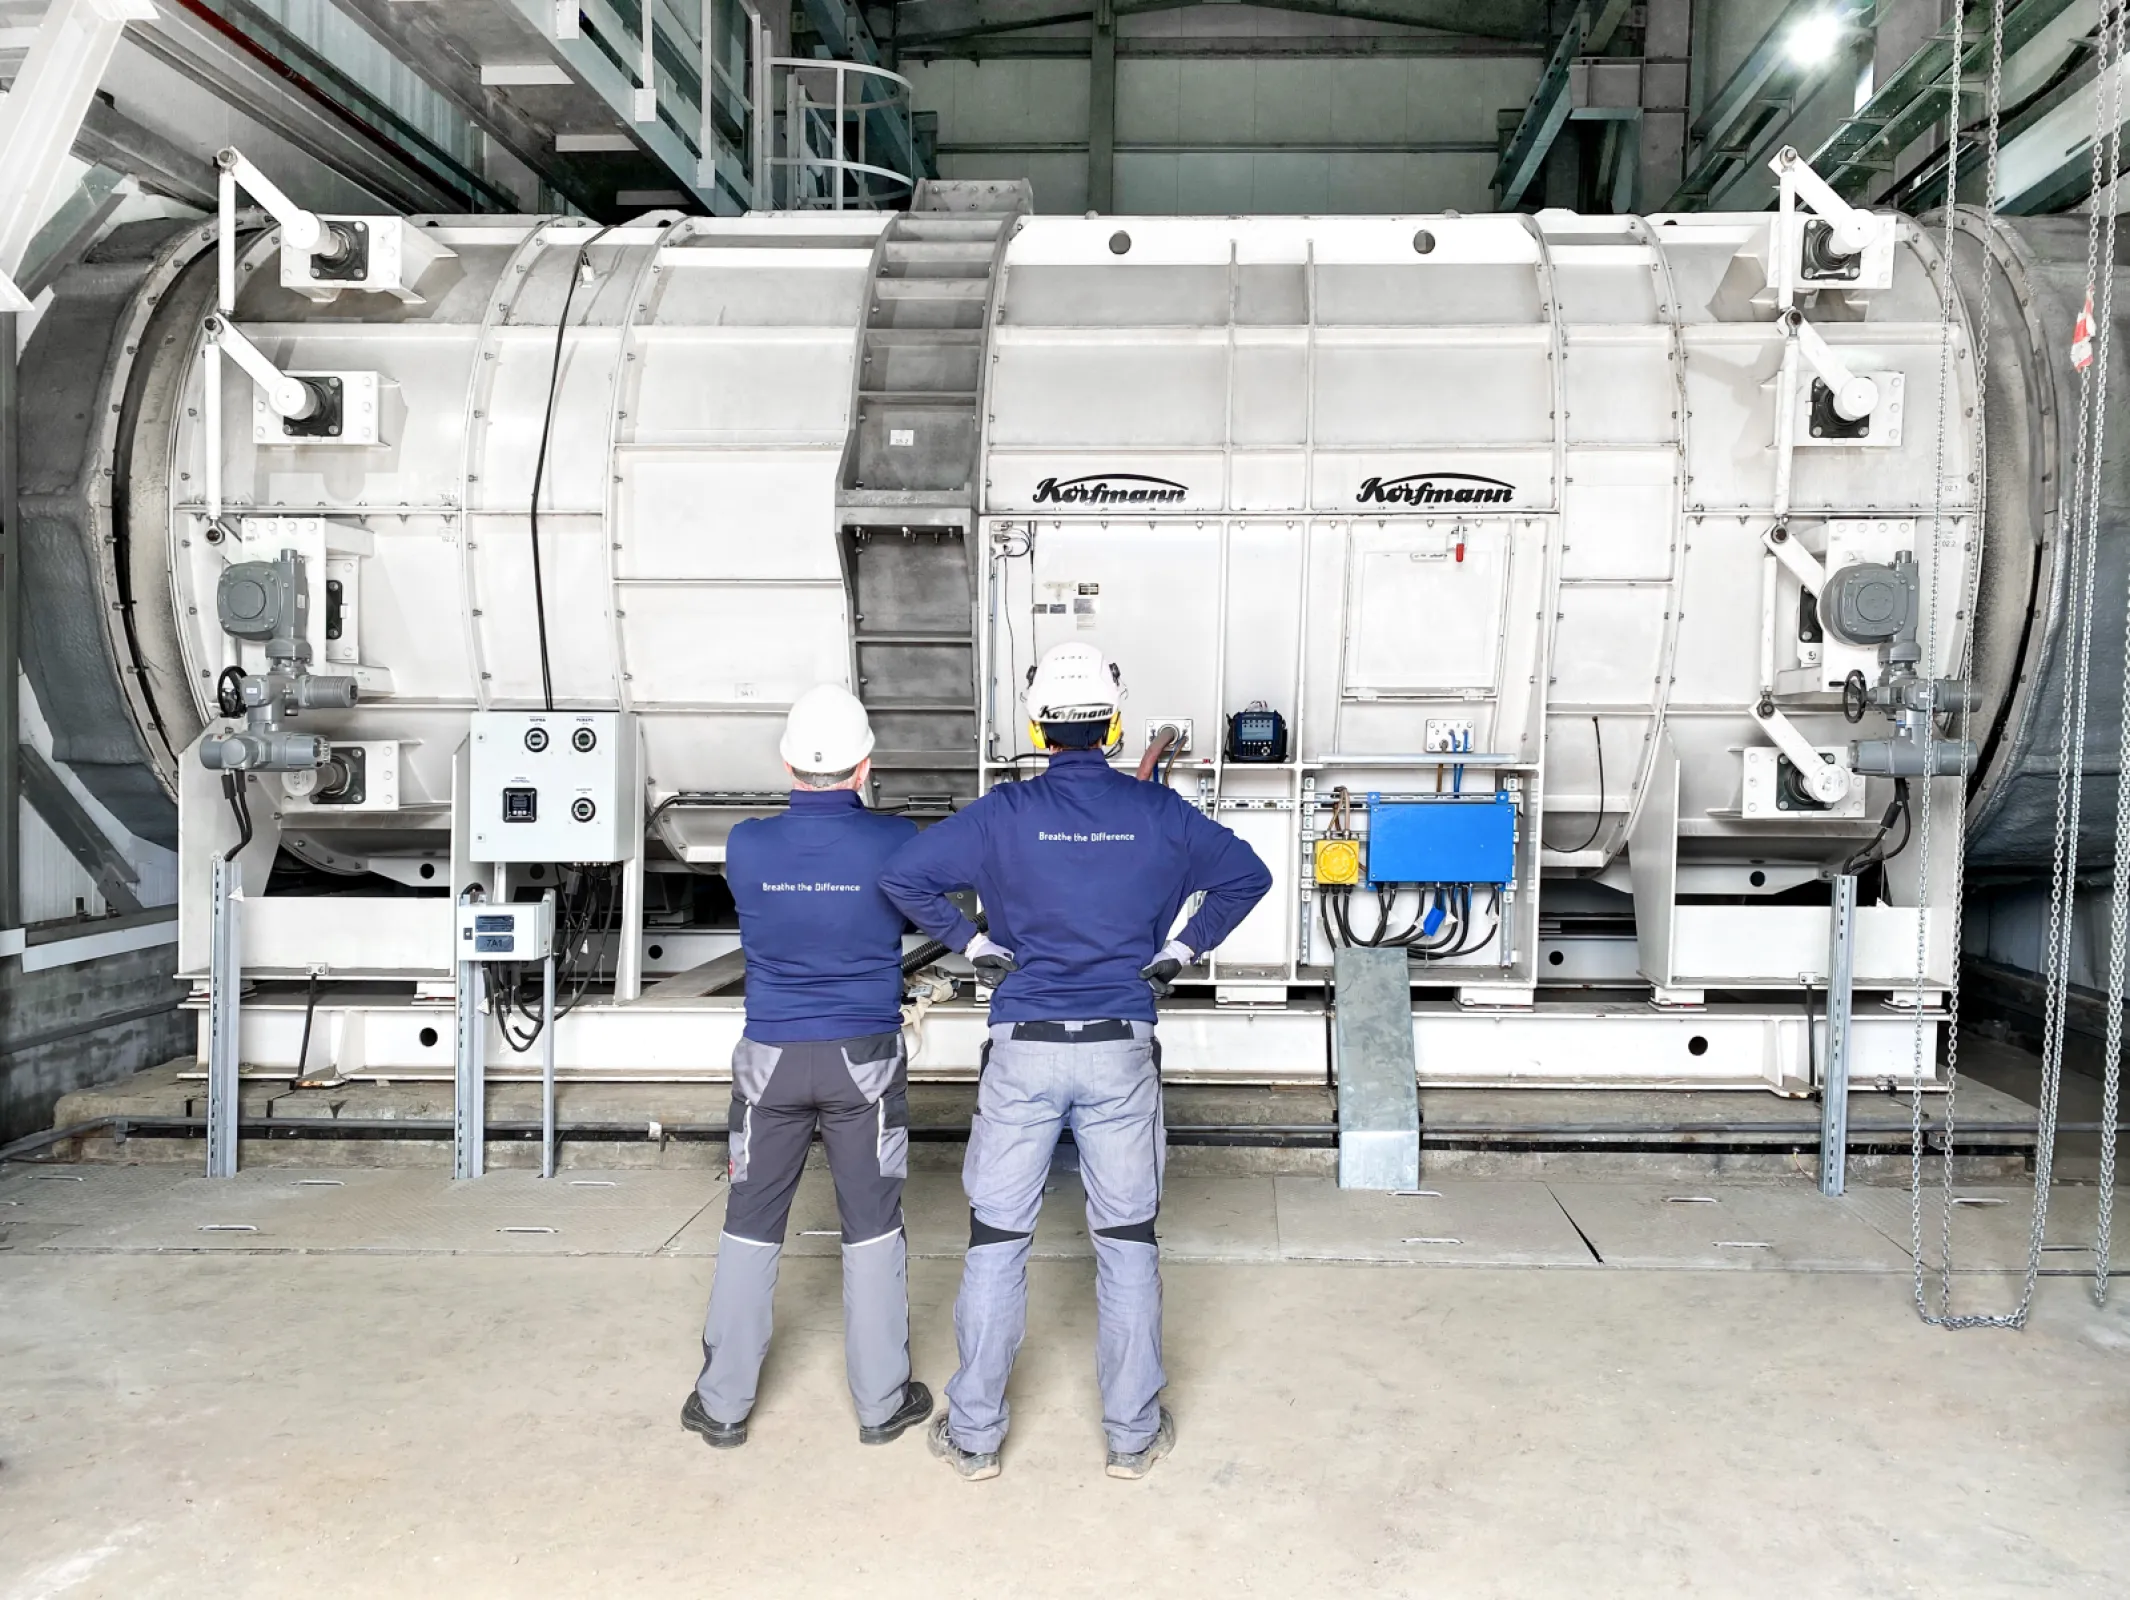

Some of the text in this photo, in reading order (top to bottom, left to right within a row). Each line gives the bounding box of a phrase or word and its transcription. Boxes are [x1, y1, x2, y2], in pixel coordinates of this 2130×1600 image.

[1032, 477, 1187, 506] Korfmann
[1356, 477, 1514, 506] Korfmann
[1039, 705, 1114, 720] Korfmann
[1039, 831, 1135, 842] Breathe the Difference
[762, 882, 861, 892] Breathe the Difference
[486, 939, 503, 948] 7A1
